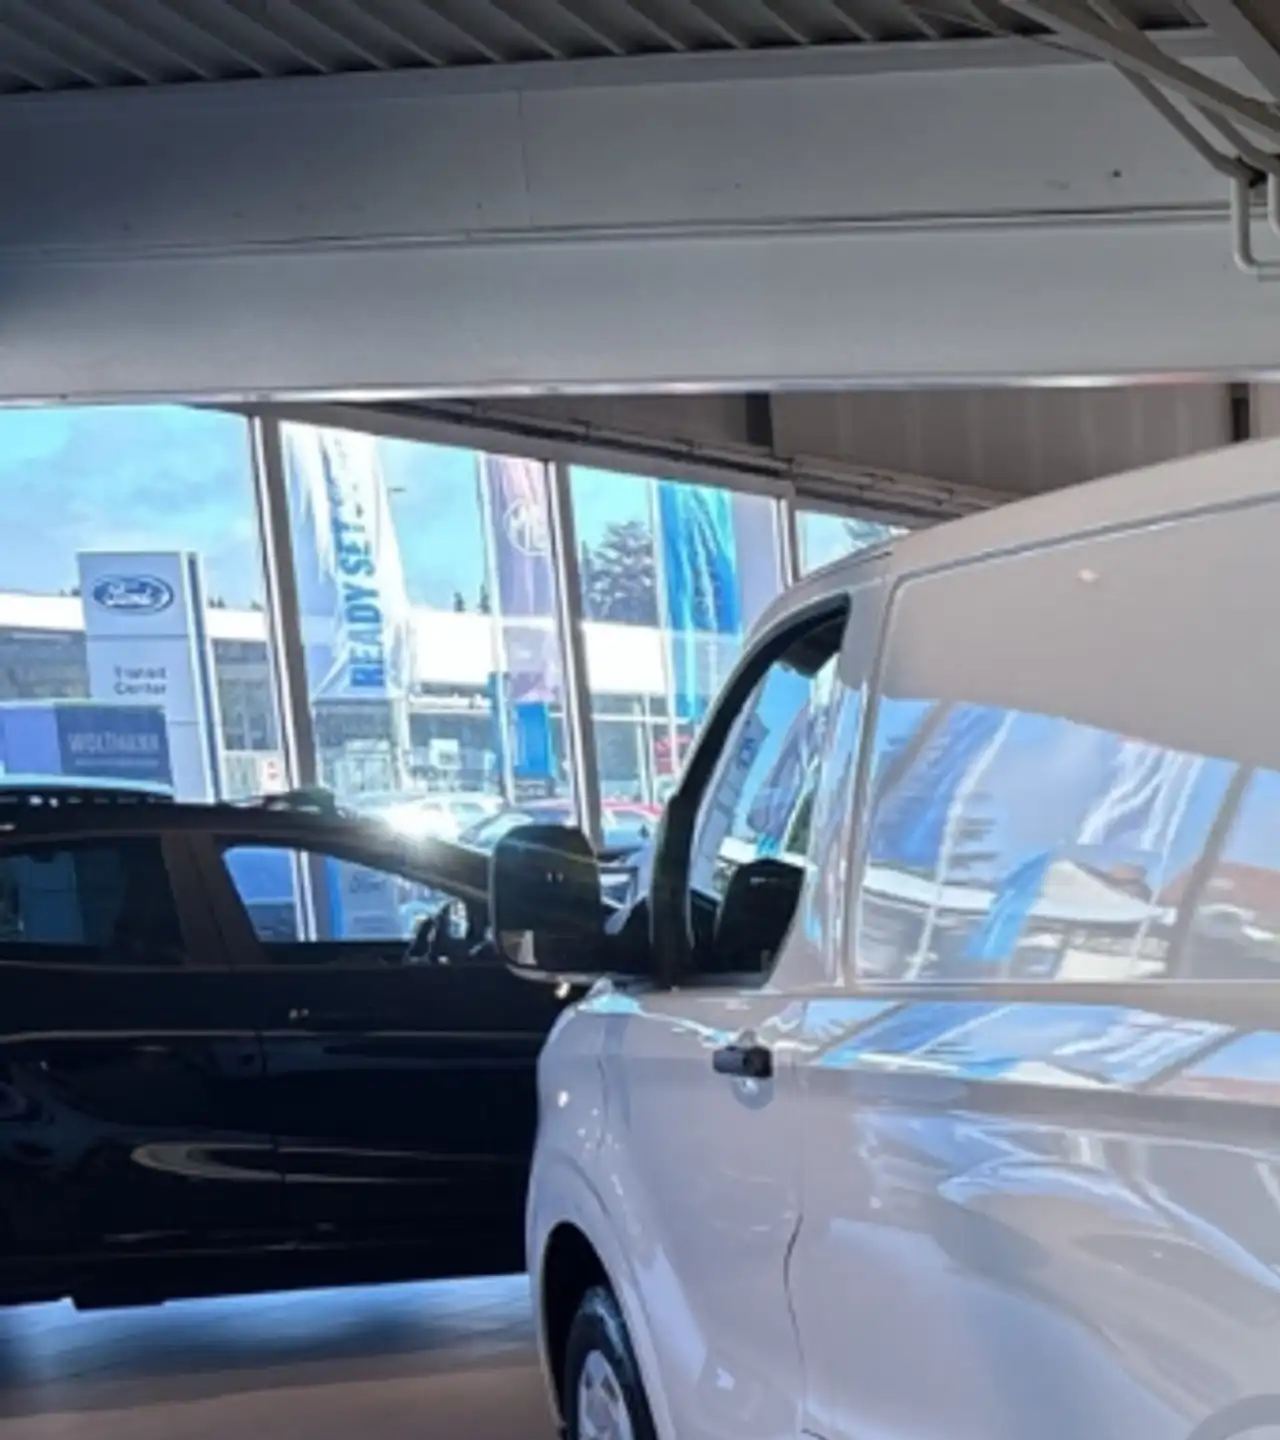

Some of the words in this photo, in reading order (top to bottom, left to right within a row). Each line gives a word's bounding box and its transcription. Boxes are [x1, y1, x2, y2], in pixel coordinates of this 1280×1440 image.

[331, 515, 376, 577] SET
[338, 581, 386, 688] READY
[113, 681, 167, 696] Center
